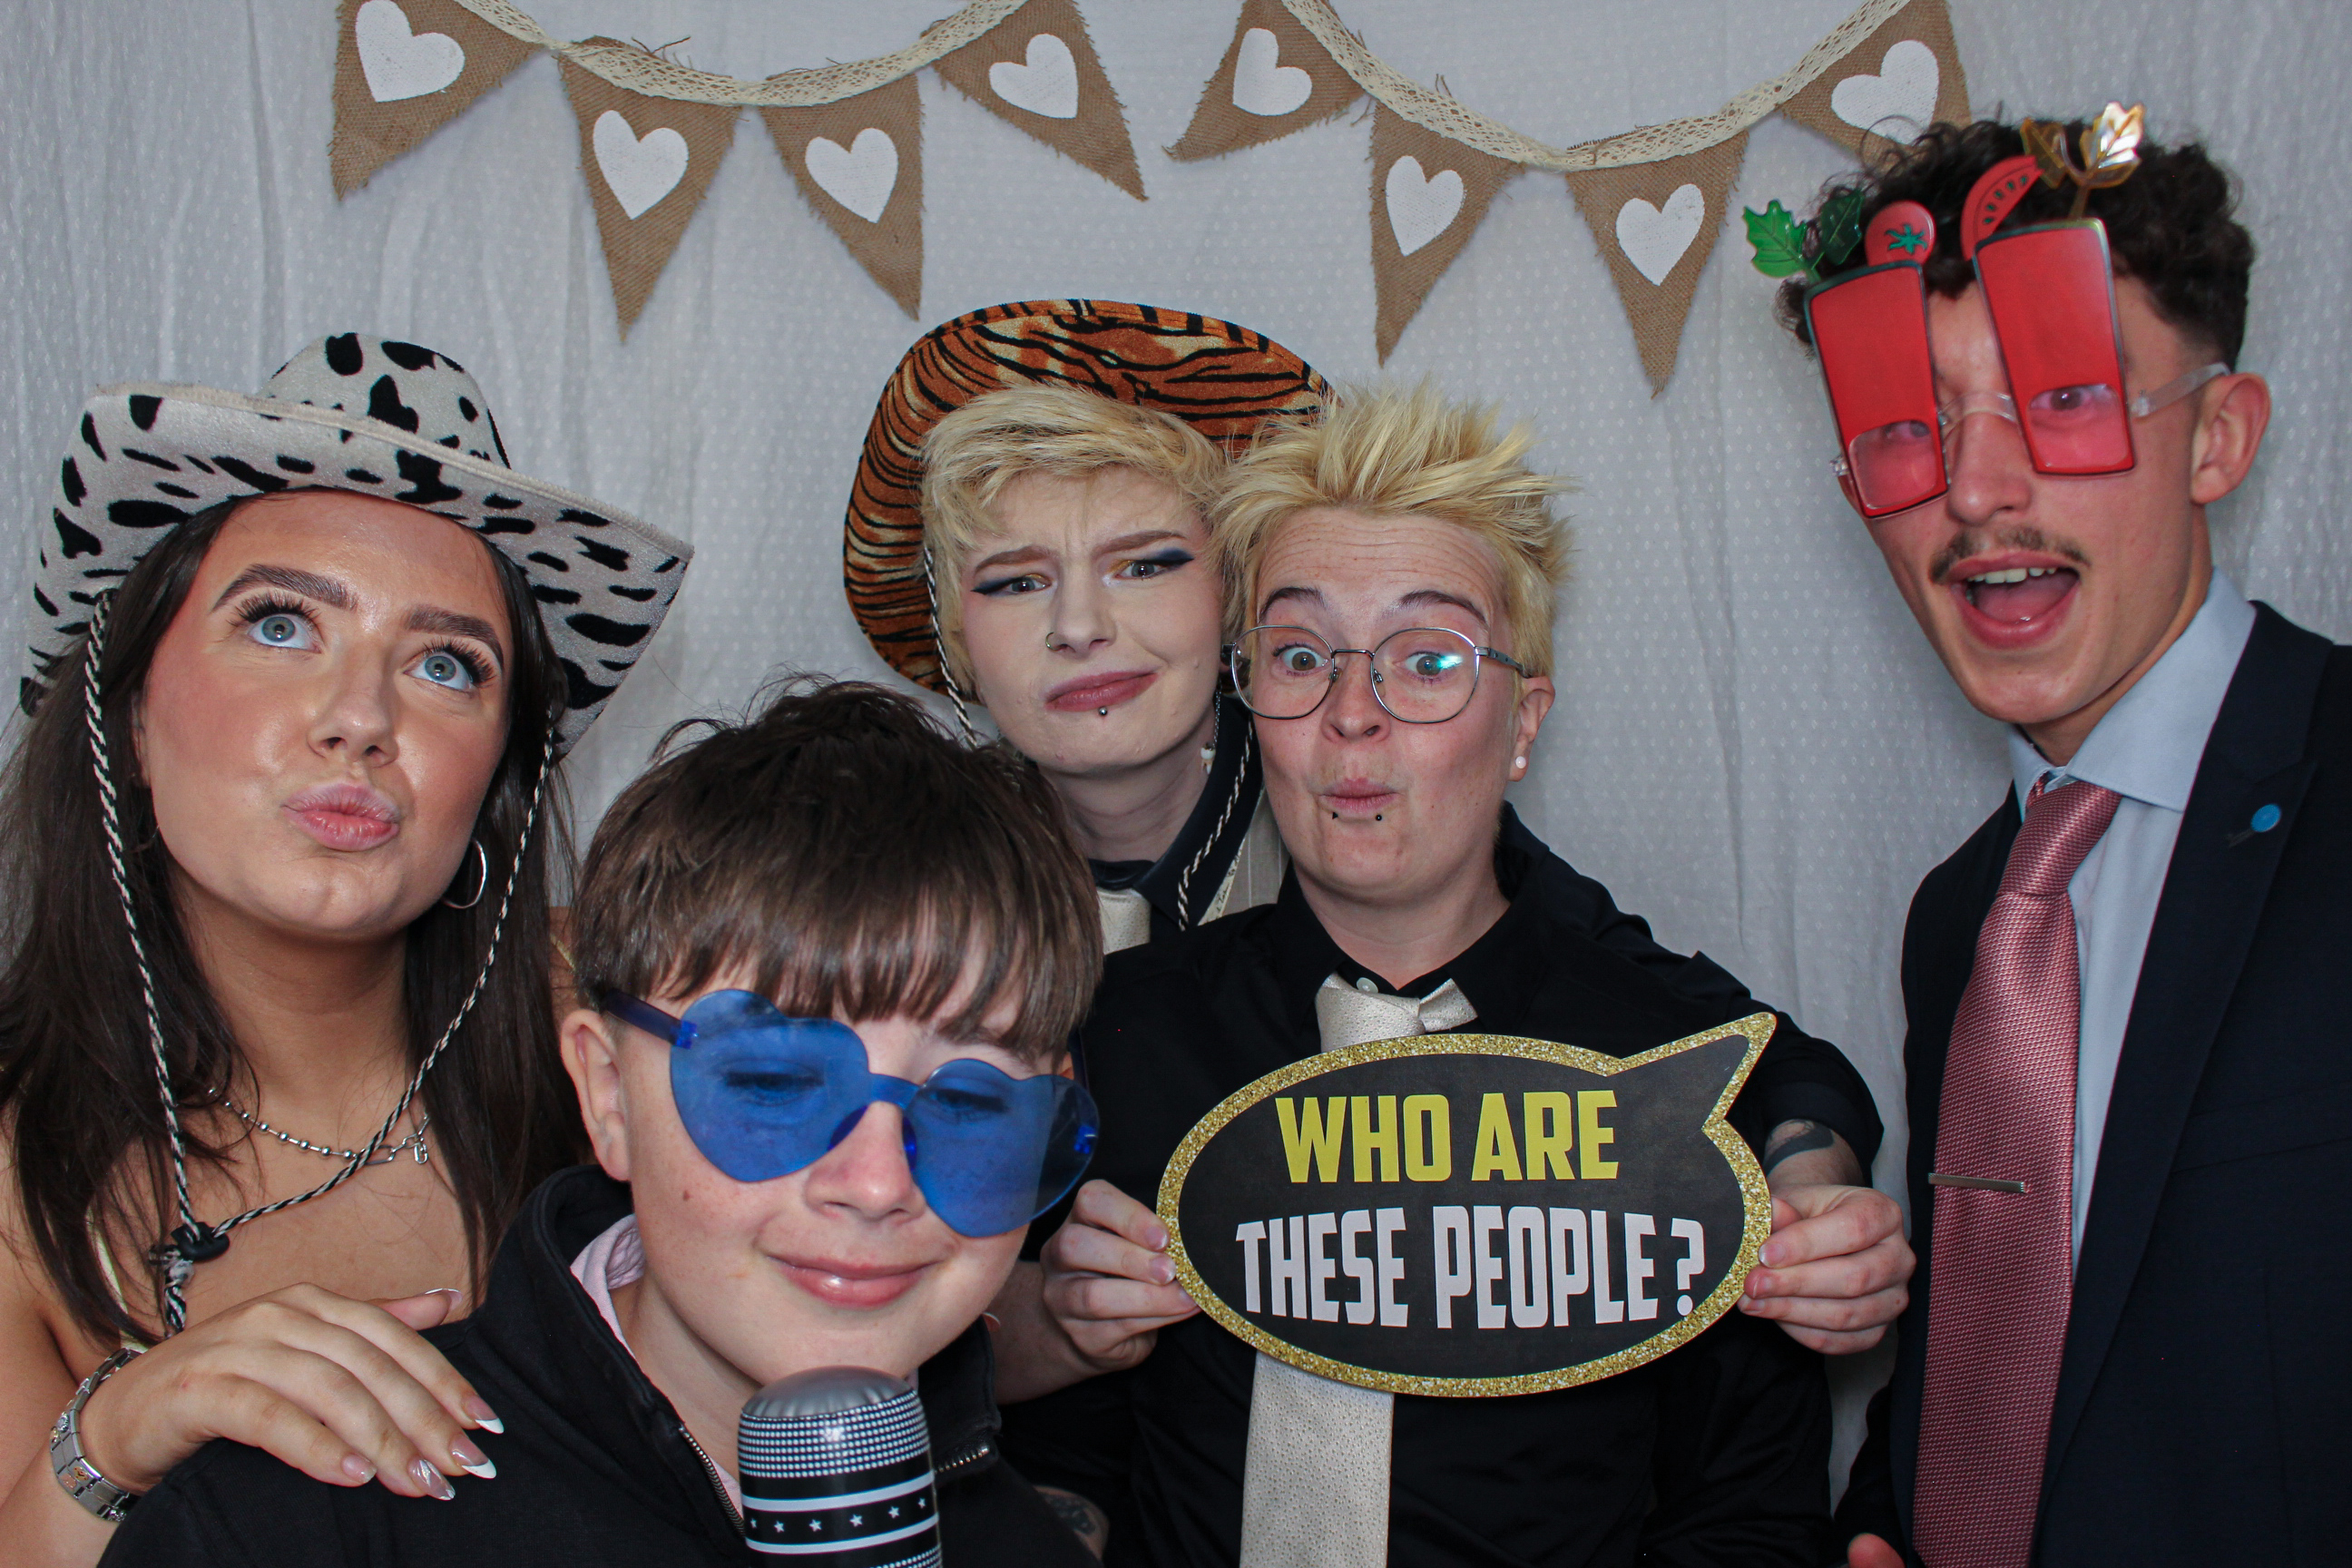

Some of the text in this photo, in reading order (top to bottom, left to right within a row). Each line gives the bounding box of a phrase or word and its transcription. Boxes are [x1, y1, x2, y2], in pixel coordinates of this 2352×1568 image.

[1274, 1089, 1620, 1183] WHO ARE
[1235, 1207, 1409, 1328] THESE
